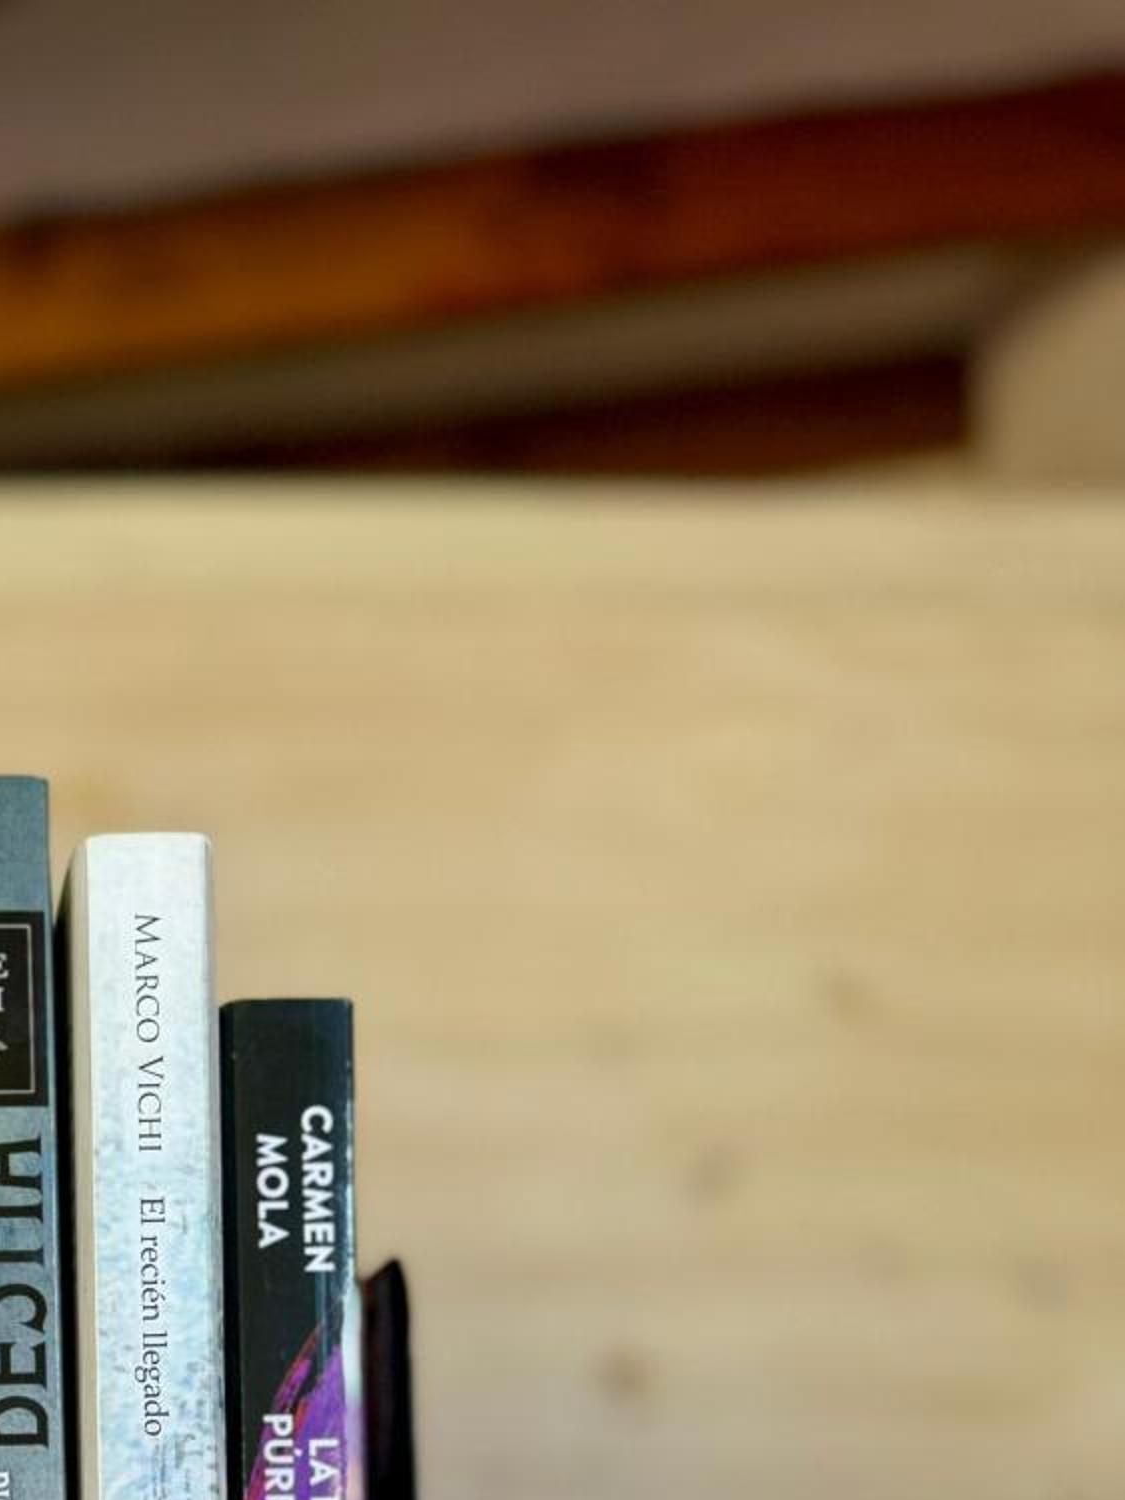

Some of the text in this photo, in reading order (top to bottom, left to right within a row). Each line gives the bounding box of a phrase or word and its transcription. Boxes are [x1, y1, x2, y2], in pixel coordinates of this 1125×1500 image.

[133, 912, 165, 1154] MARCO VICHI
[255, 1132, 290, 1250] MOLA
[300, 1105, 337, 1274] CARMEN
[133, 1196, 169, 1438] El recién llegado
[308, 1437, 339, 1487] LA
